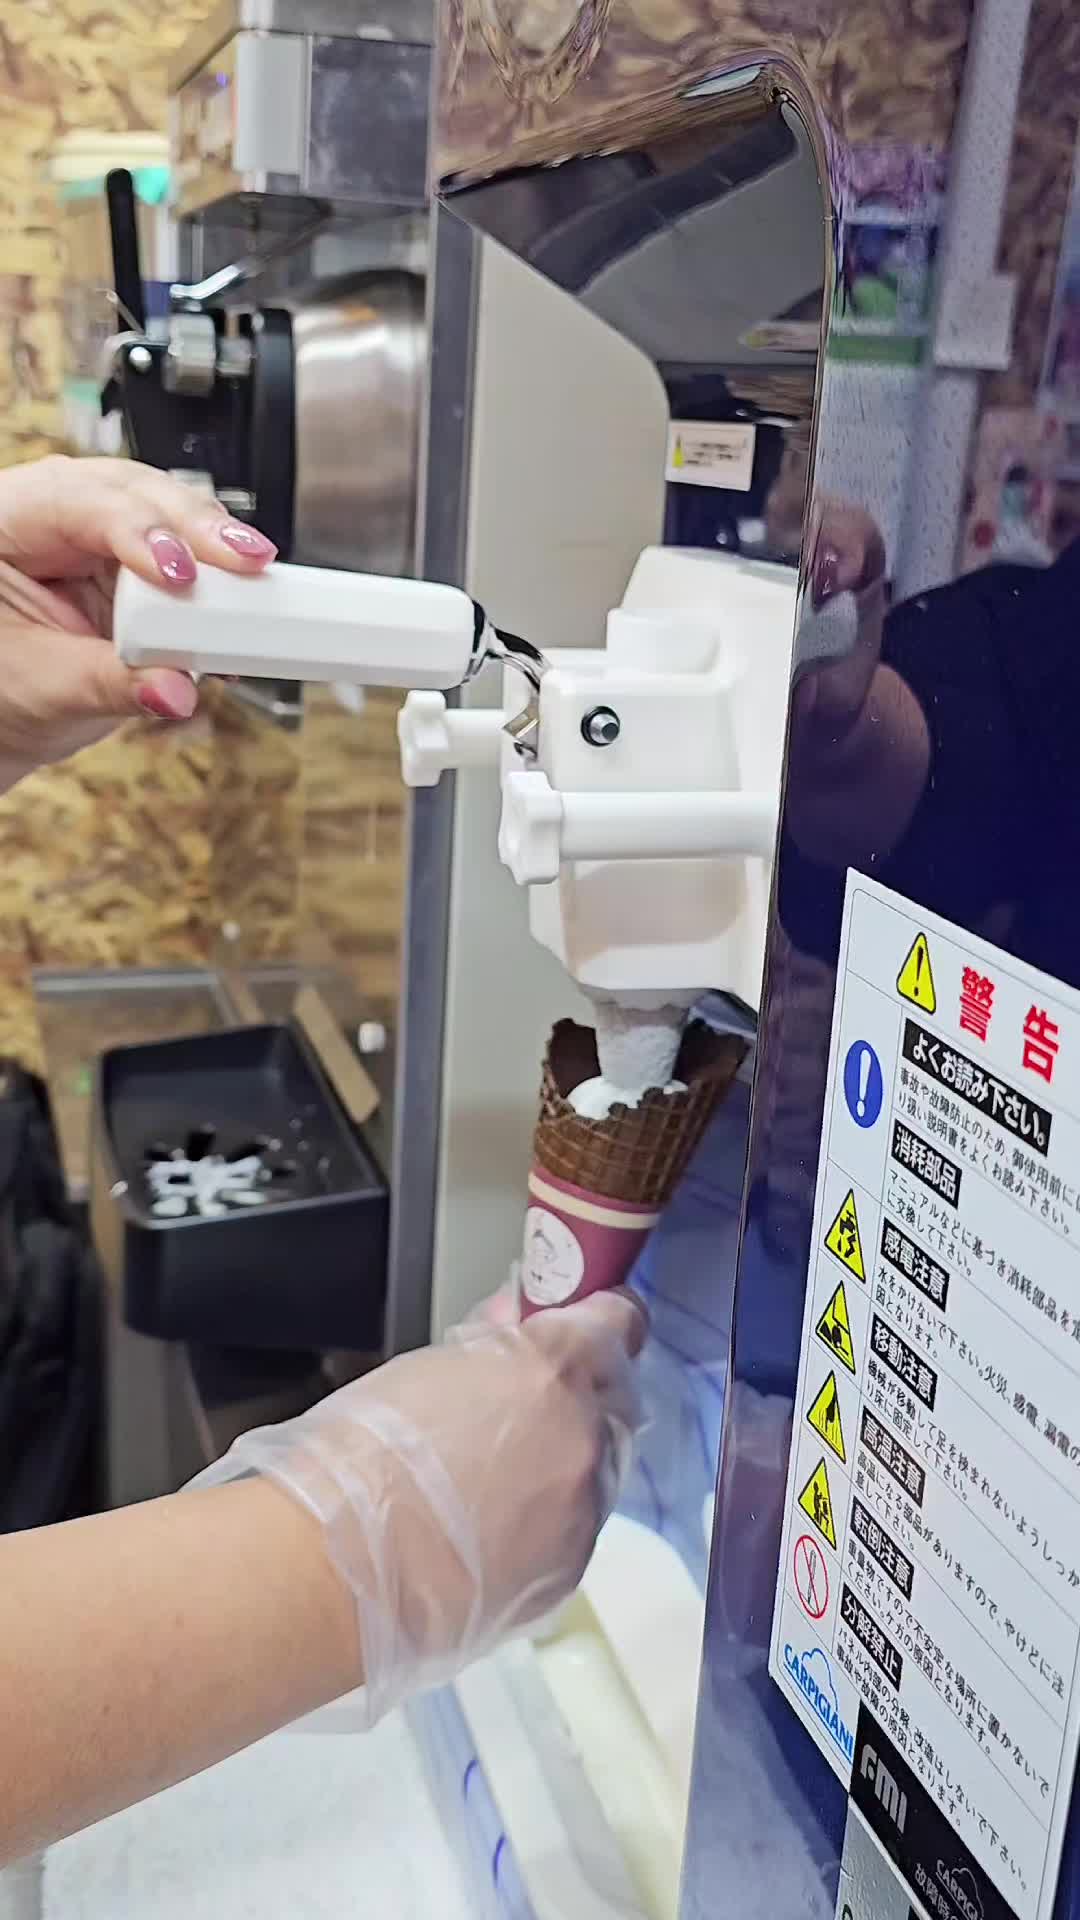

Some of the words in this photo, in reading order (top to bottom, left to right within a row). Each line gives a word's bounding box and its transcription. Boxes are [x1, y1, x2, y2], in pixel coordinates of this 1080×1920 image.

[959, 966, 1060, 1085] 警告
[912, 1033, 1046, 1147] よくお読み下さい。
[893, 1126, 959, 1201] 消耗部品
[882, 1228, 948, 1306] 感電注意
[886, 1190, 972, 1277] に交換して下さい。
[873, 1320, 937, 1402] 移動注意
[875, 1286, 938, 1358] 因となります。
[877, 1266, 1080, 1466] 水をかけないで下さい。火災、感電、漏電の
[862, 1415, 924, 1499] 高温注意
[866, 1381, 968, 1501] り床に固定して下さい。
[852, 1507, 912, 1594] 転倒注意
[855, 1470, 915, 1550] 意して下さい。
[841, 1590, 900, 1684] 分解禁止
[784, 1644, 853, 1759] CARPIGIANI
[937, 1859, 982, 1920] CARPIG
